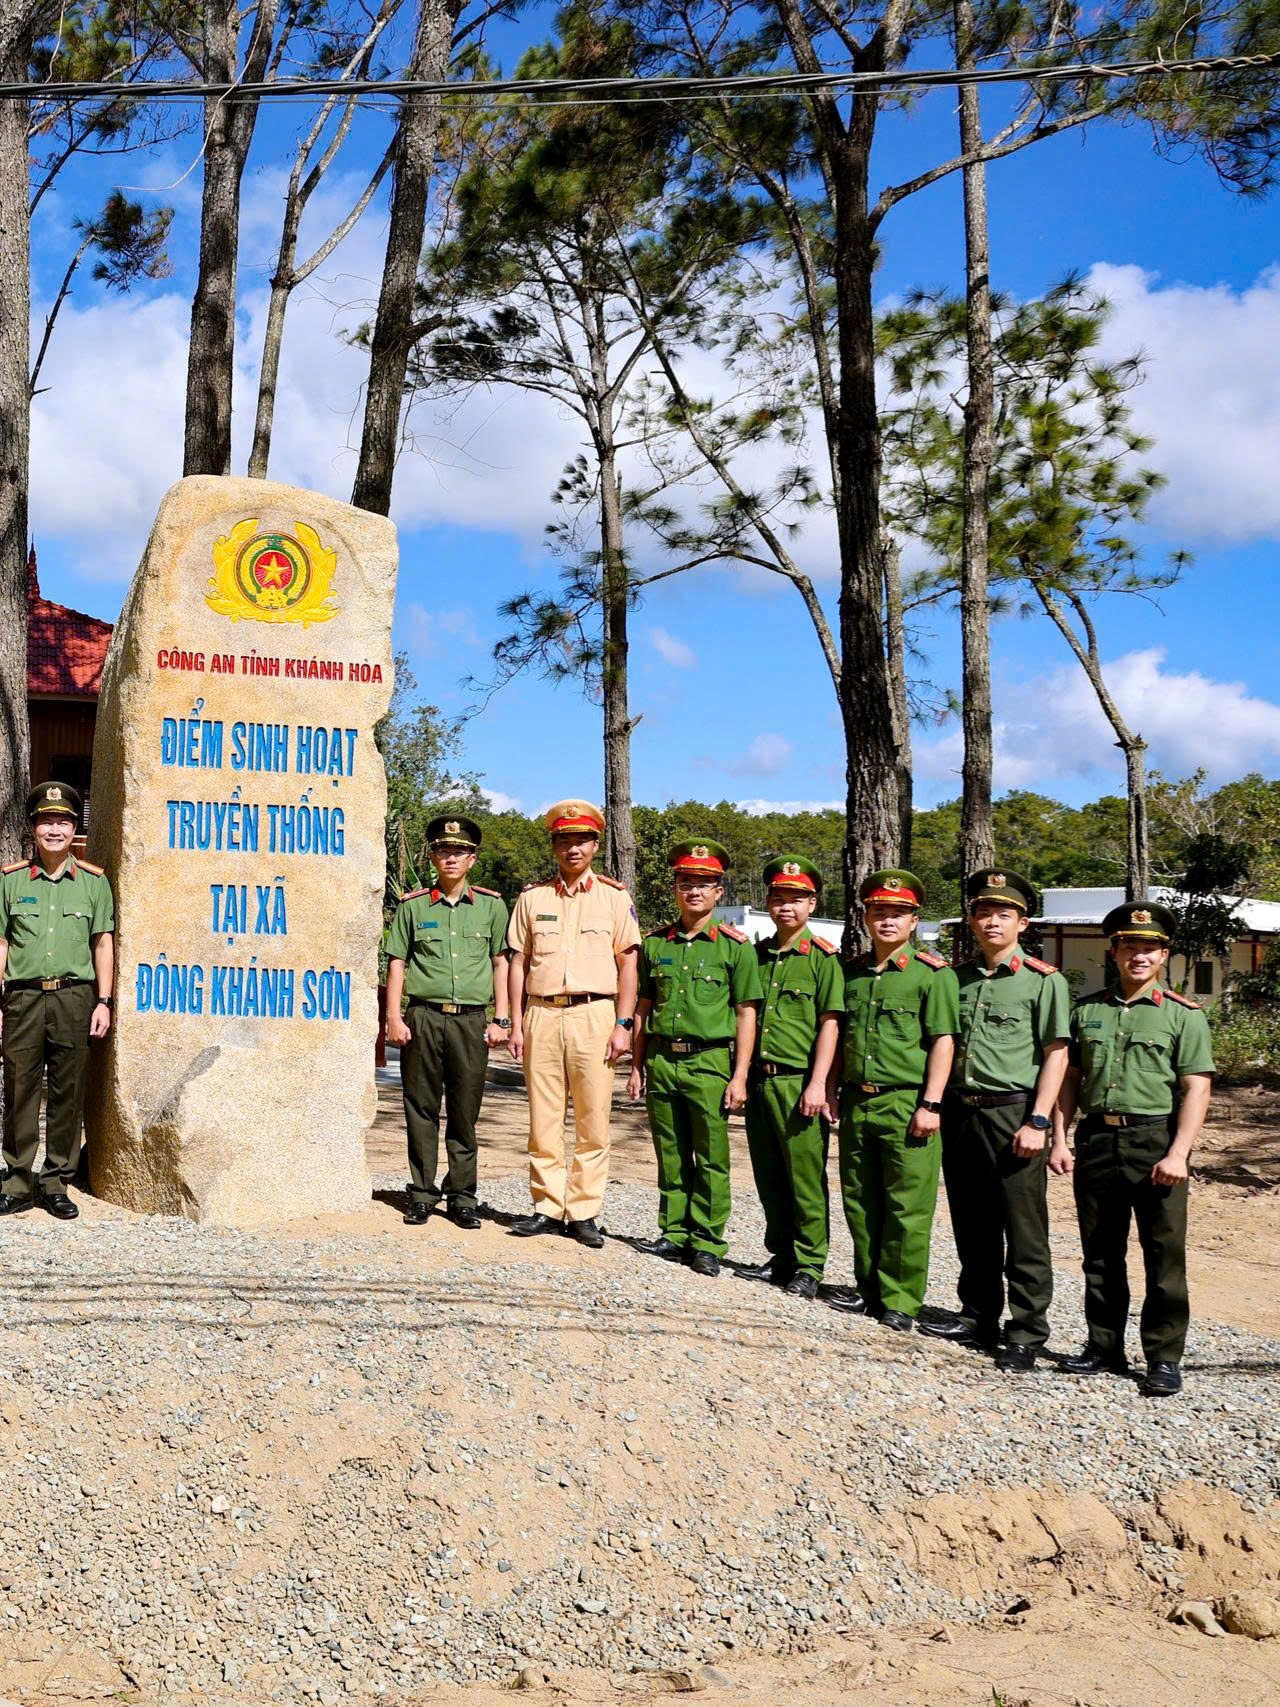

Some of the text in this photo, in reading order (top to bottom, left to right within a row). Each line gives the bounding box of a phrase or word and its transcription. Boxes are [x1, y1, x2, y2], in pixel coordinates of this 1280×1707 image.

[157, 646, 383, 684] CÔNG AN TỈNH KHÁNH HÒA
[161, 698, 359, 788] ĐIỂM SINH HOẠT
[267, 787, 345, 856] THỐNG
[210, 875, 288, 946] TẠI XÃ
[136, 952, 351, 1021] ĐÔNG KHÁNH SƠN
